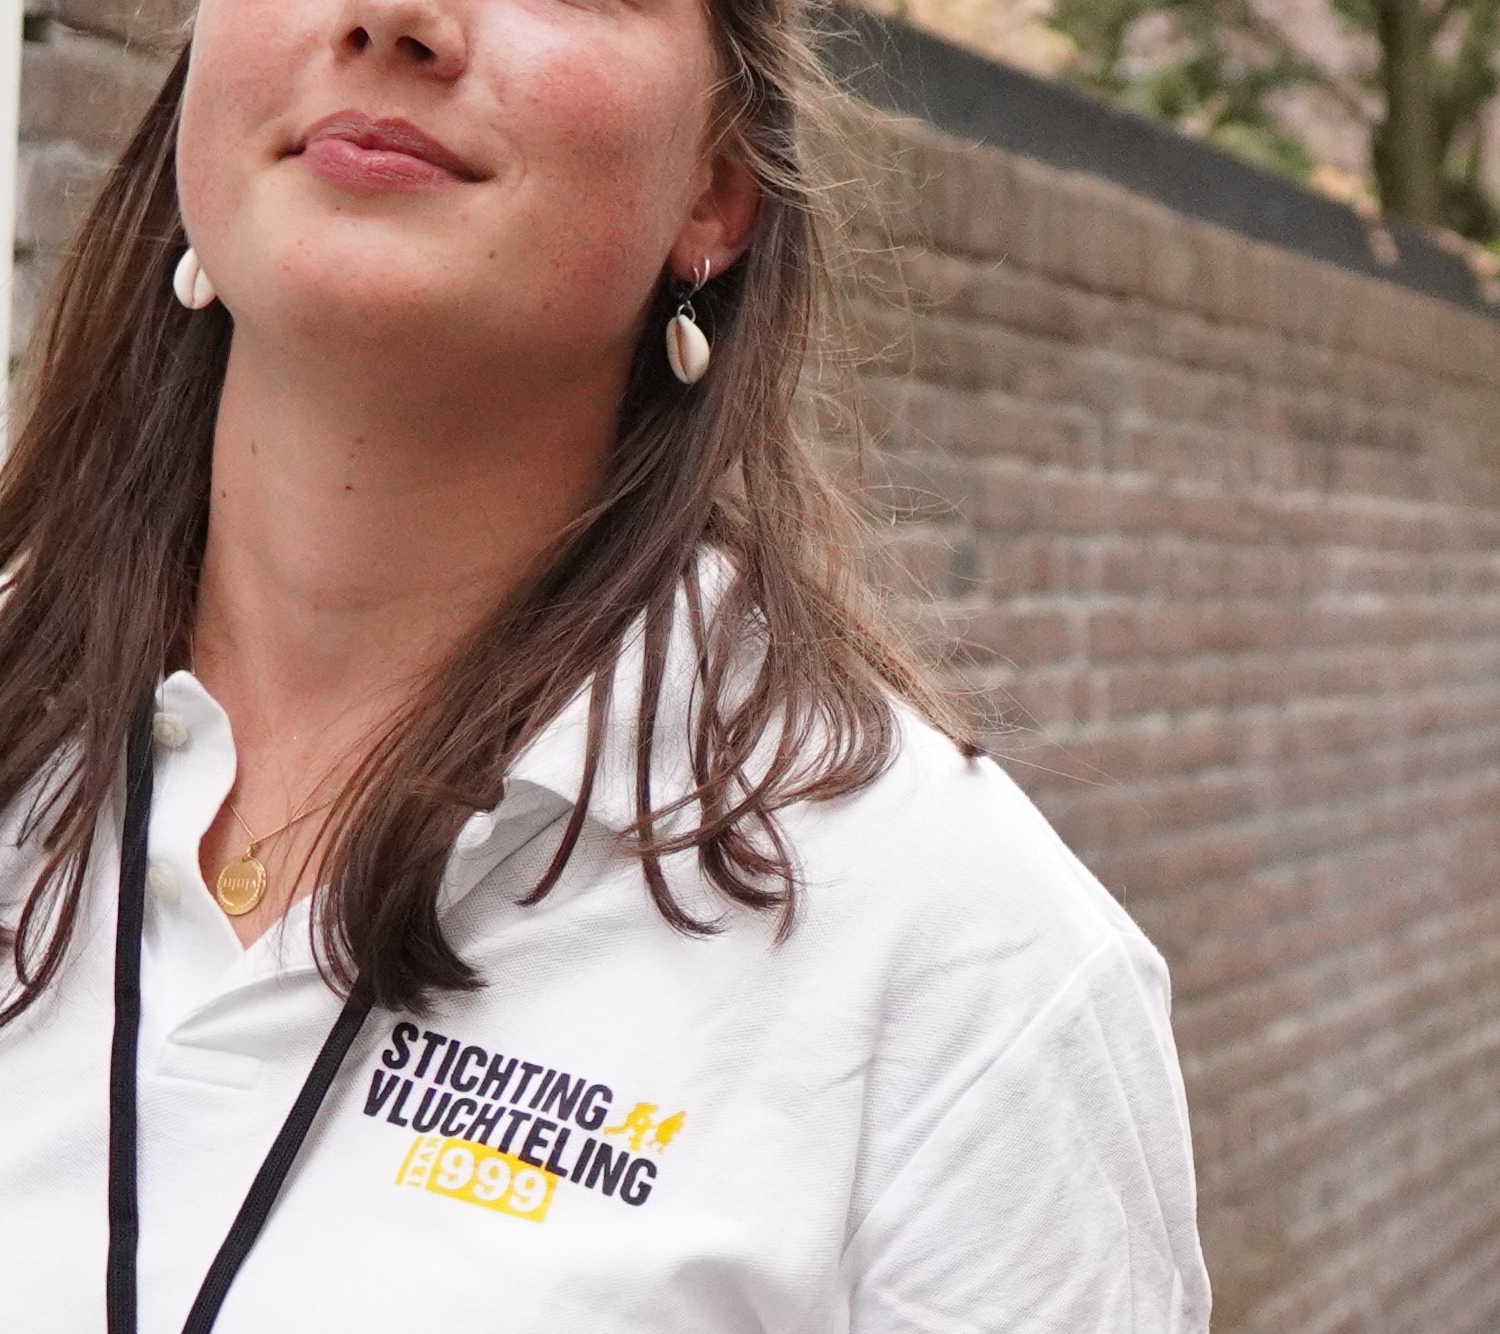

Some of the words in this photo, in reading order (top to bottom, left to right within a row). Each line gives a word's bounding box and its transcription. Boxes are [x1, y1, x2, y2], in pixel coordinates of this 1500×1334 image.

[381, 1022, 613, 1131] STICHTING
[363, 1069, 657, 1206] VLUCHTELING
[435, 1147, 548, 1212] 999
